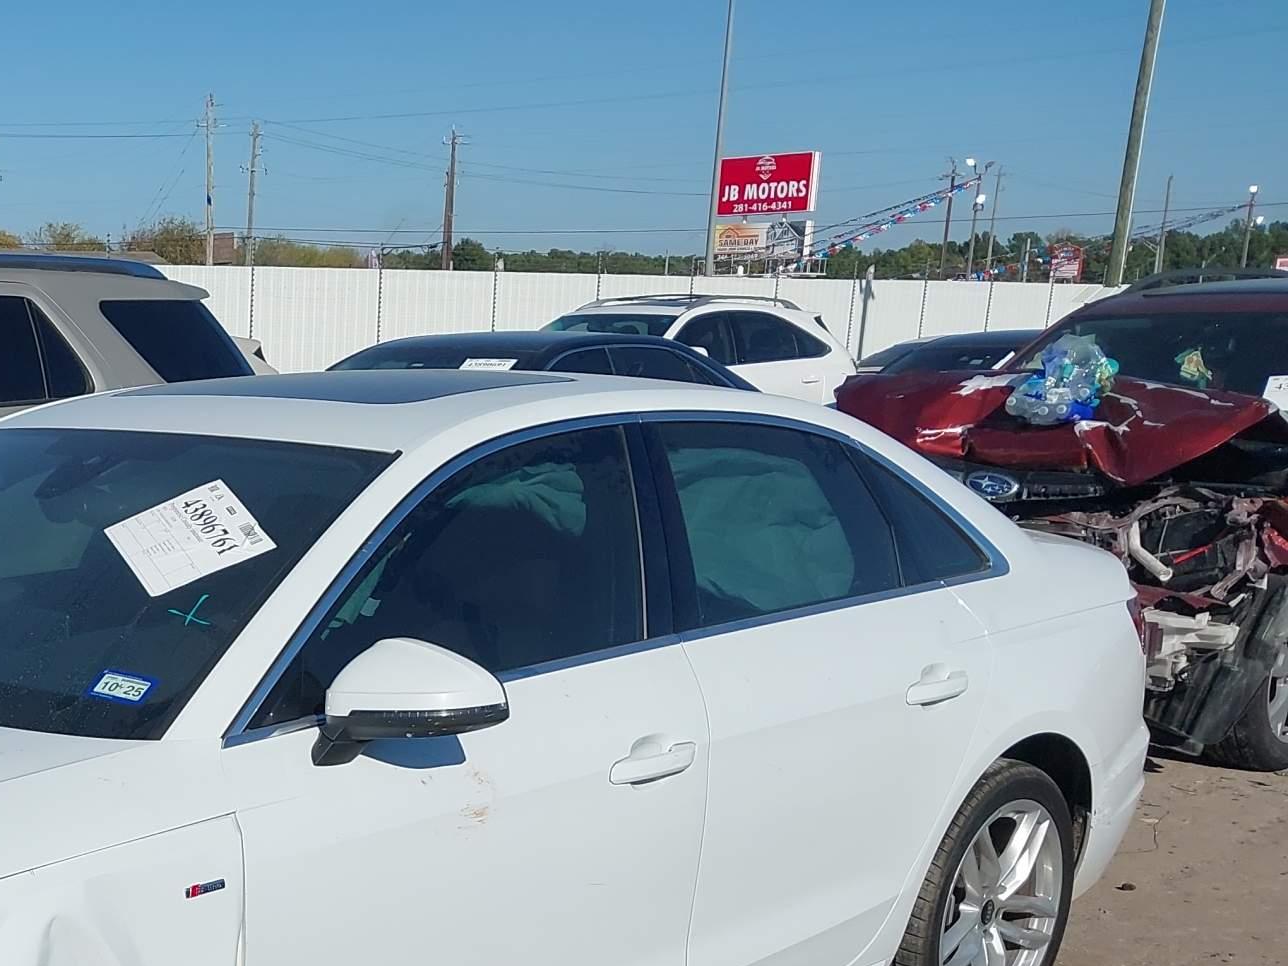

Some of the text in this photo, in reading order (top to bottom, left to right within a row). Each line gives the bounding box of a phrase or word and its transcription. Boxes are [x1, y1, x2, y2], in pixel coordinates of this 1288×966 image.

[722, 180, 807, 202] JB MOTORS
[733, 201, 792, 213] 281-416-4341
[719, 238, 759, 247] SAME DAY
[181, 499, 240, 556] 43896761
